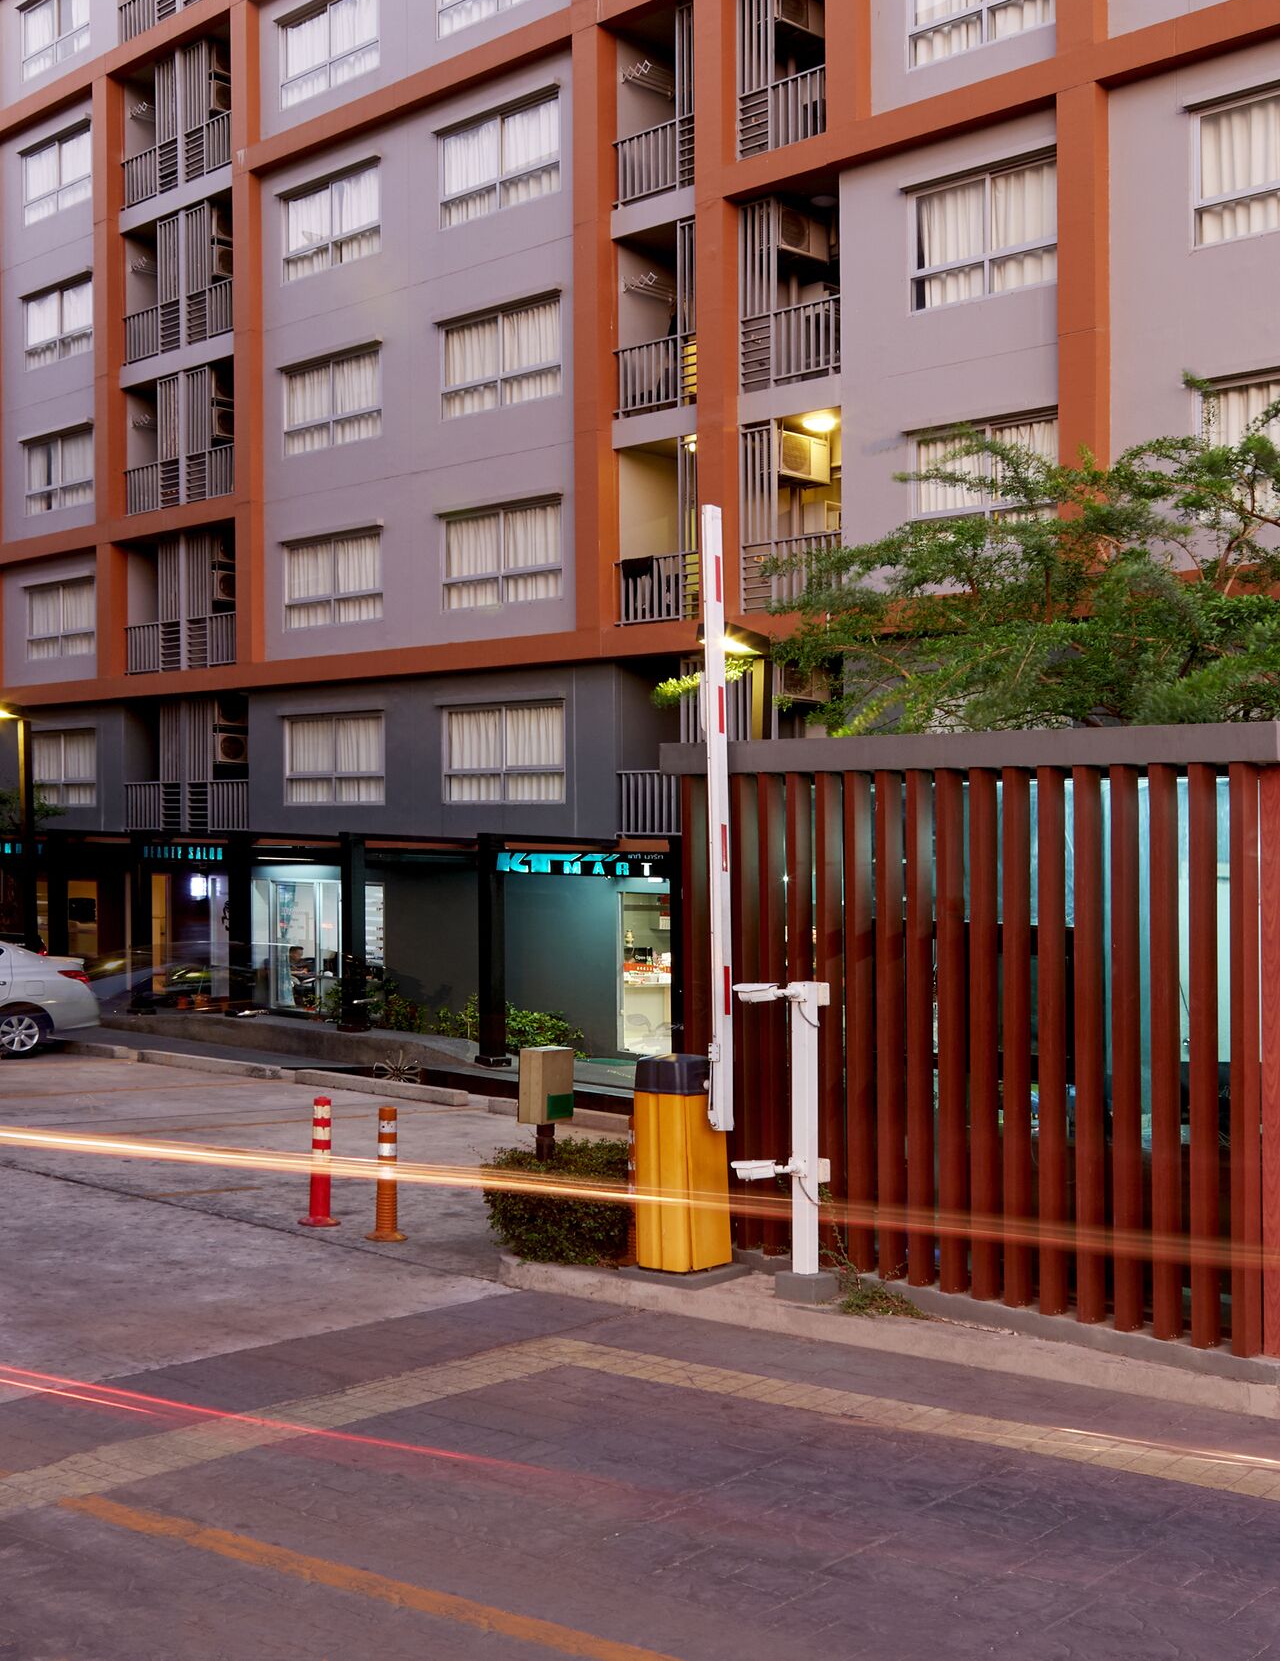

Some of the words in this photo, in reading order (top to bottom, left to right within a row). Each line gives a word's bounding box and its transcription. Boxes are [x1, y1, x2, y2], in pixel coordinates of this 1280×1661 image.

[143, 846, 182, 859] BEAUTY
[188, 846, 223, 860] SALON
[563, 861, 653, 877] MART
